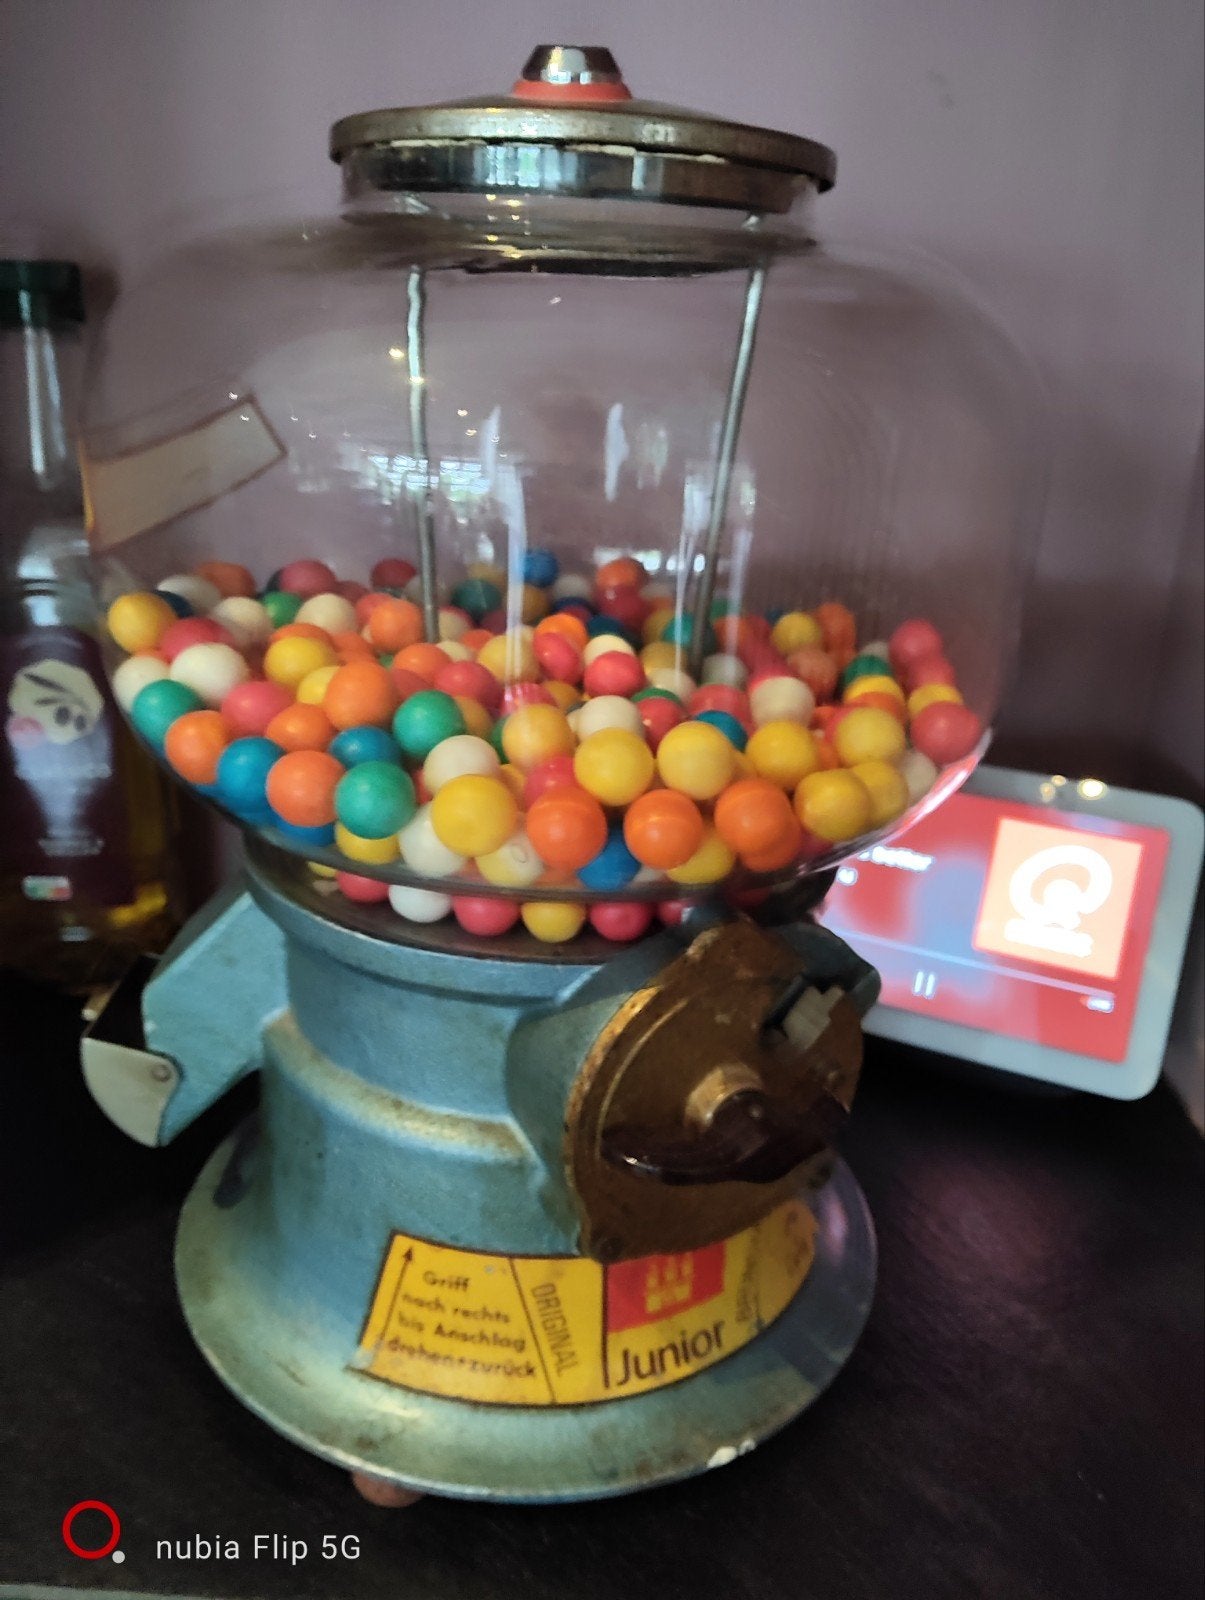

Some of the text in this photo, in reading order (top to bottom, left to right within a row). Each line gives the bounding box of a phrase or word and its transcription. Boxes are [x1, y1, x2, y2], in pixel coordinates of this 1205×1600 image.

[422, 1270, 471, 1292] Griff
[453, 1305, 510, 1324] rechts
[531, 1282, 580, 1377] ORIGINAL
[434, 1322, 526, 1354] Anschlag
[616, 1320, 725, 1386] Junior
